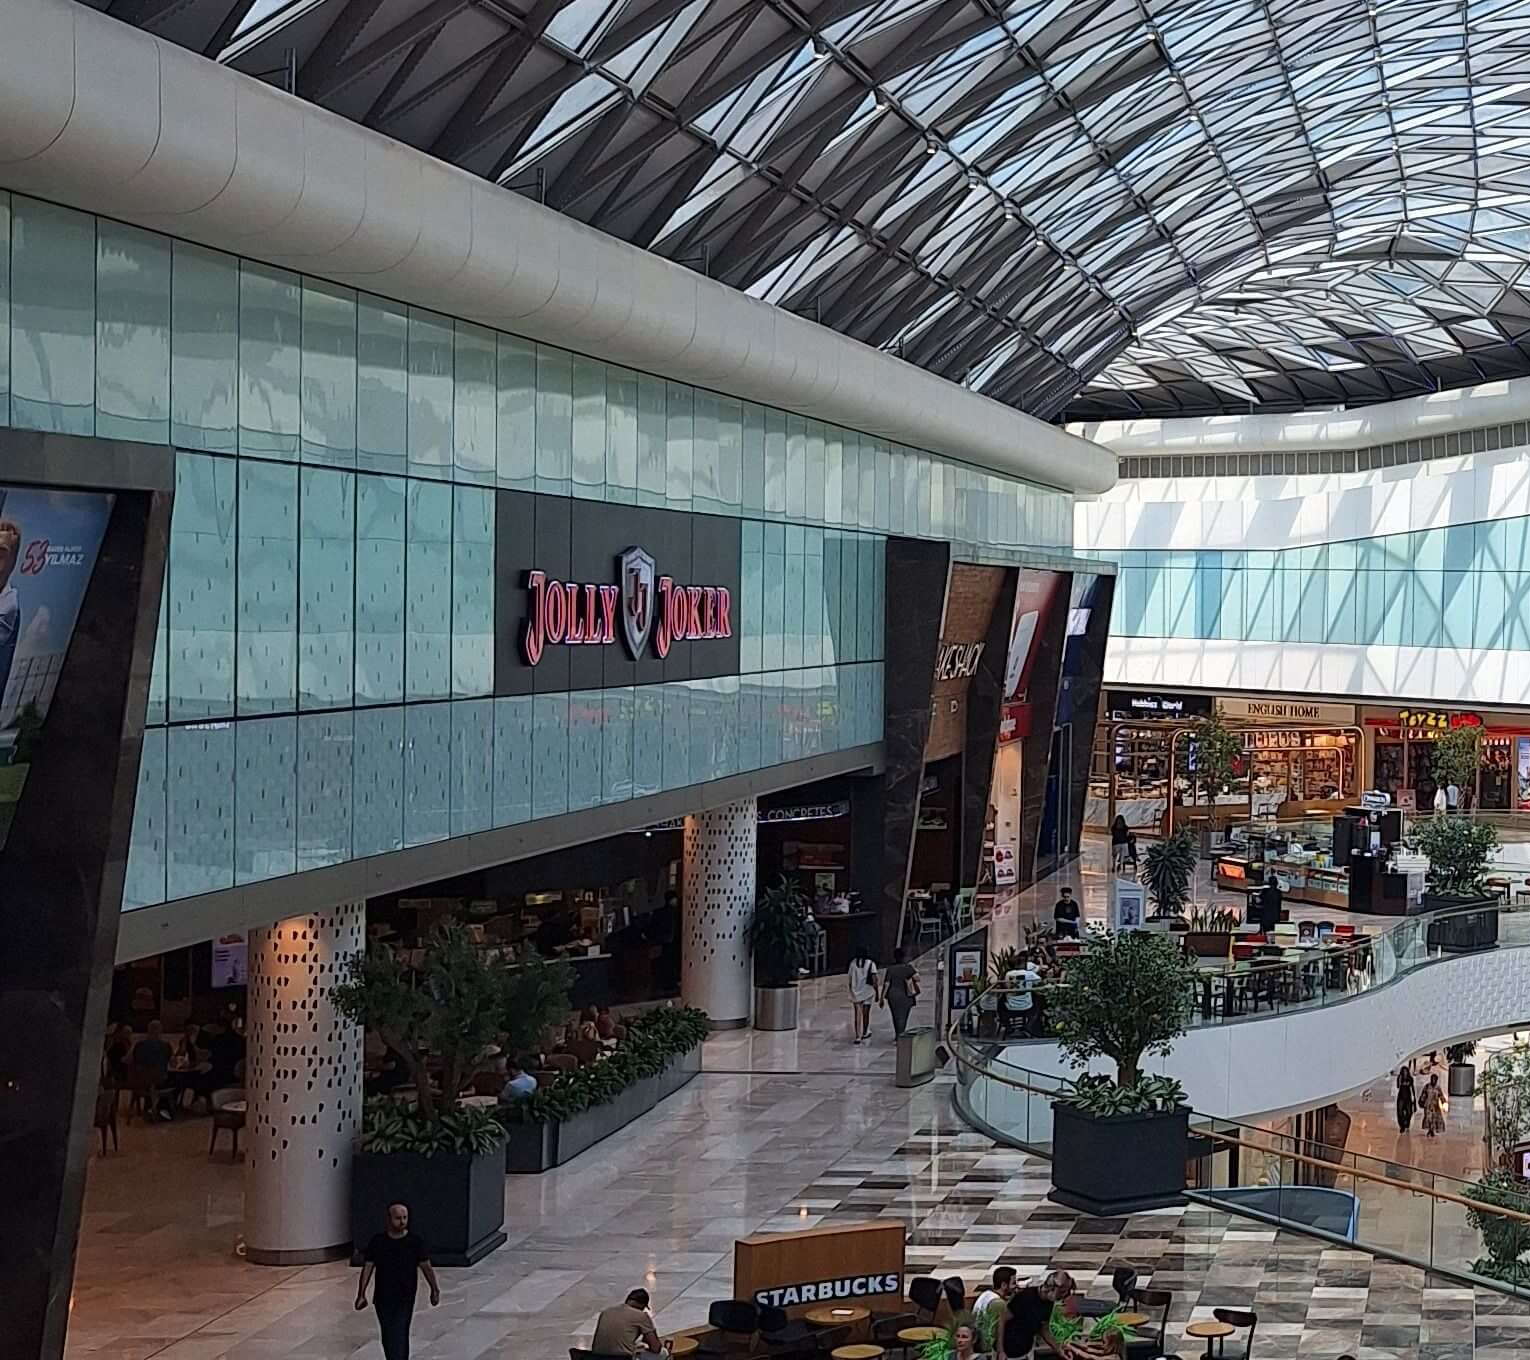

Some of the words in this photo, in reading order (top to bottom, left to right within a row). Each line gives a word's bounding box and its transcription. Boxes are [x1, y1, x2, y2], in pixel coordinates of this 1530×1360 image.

[525, 570, 619, 666] JOLLY
[656, 576, 733, 659] JOKER
[1247, 703, 1287, 716] ENGLISH
[1290, 704, 1320, 718] HOME
[756, 1274, 899, 1308] STARBUCKS
